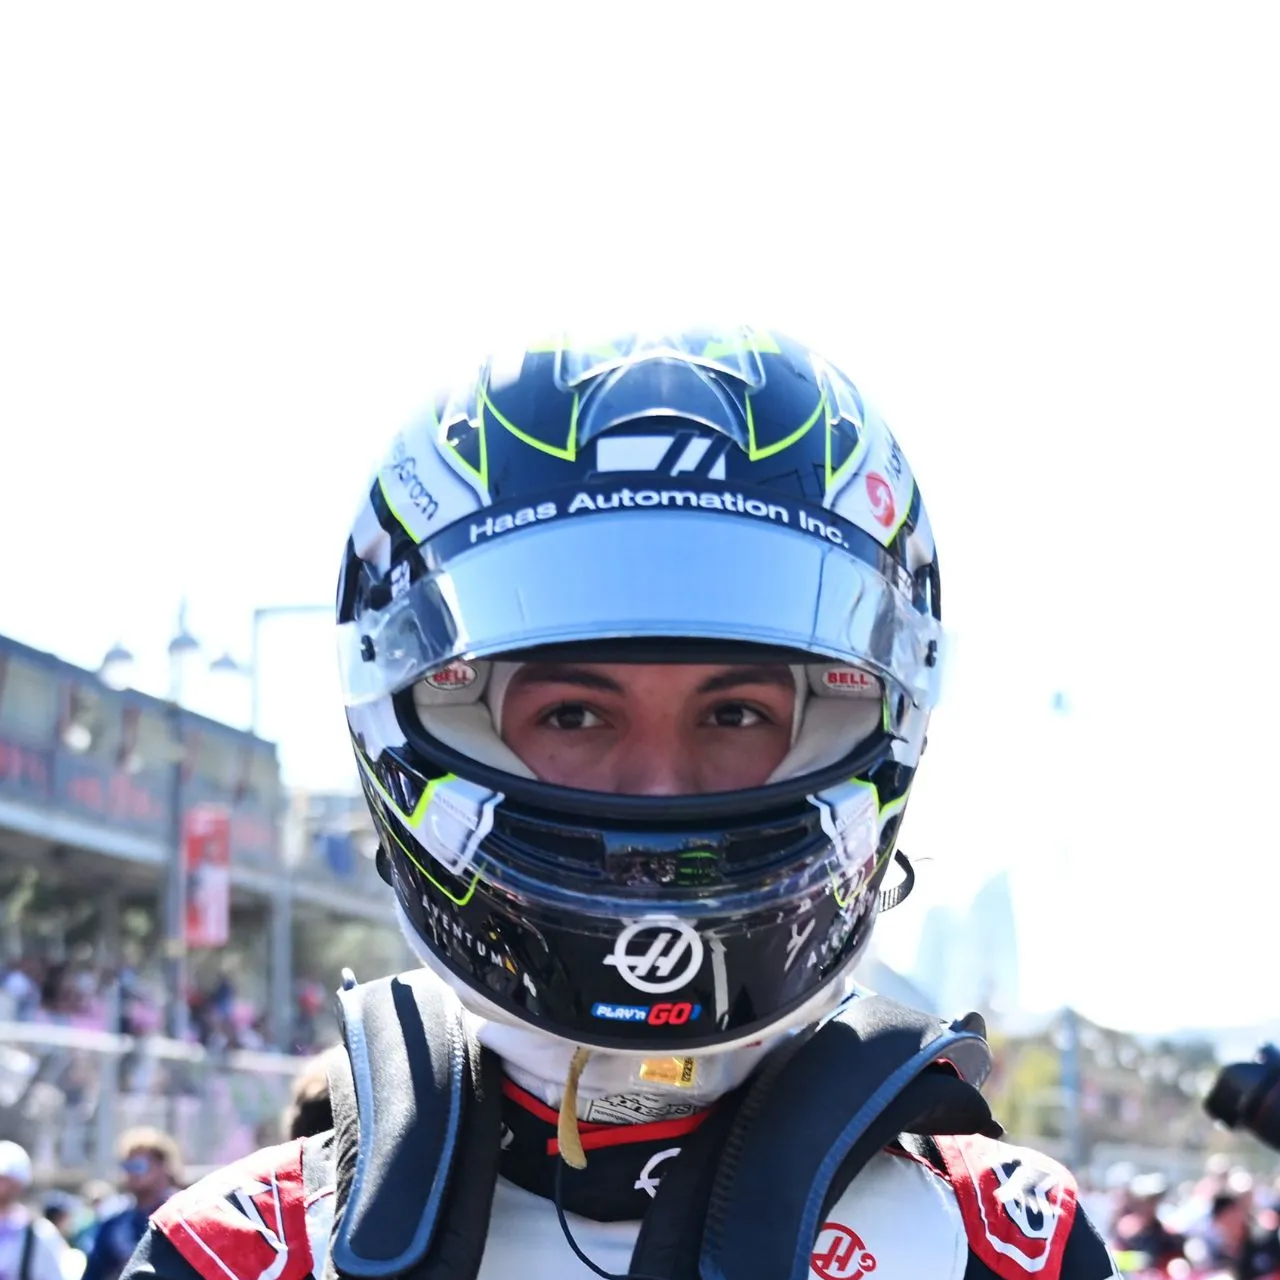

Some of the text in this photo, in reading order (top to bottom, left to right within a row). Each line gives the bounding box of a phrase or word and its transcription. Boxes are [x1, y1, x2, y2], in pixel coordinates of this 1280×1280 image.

[471, 489, 850, 548] Haas Automation Inc.
[827, 671, 869, 686] BELL
[422, 894, 504, 967] AVENTUM
[647, 1002, 692, 1025] GO
